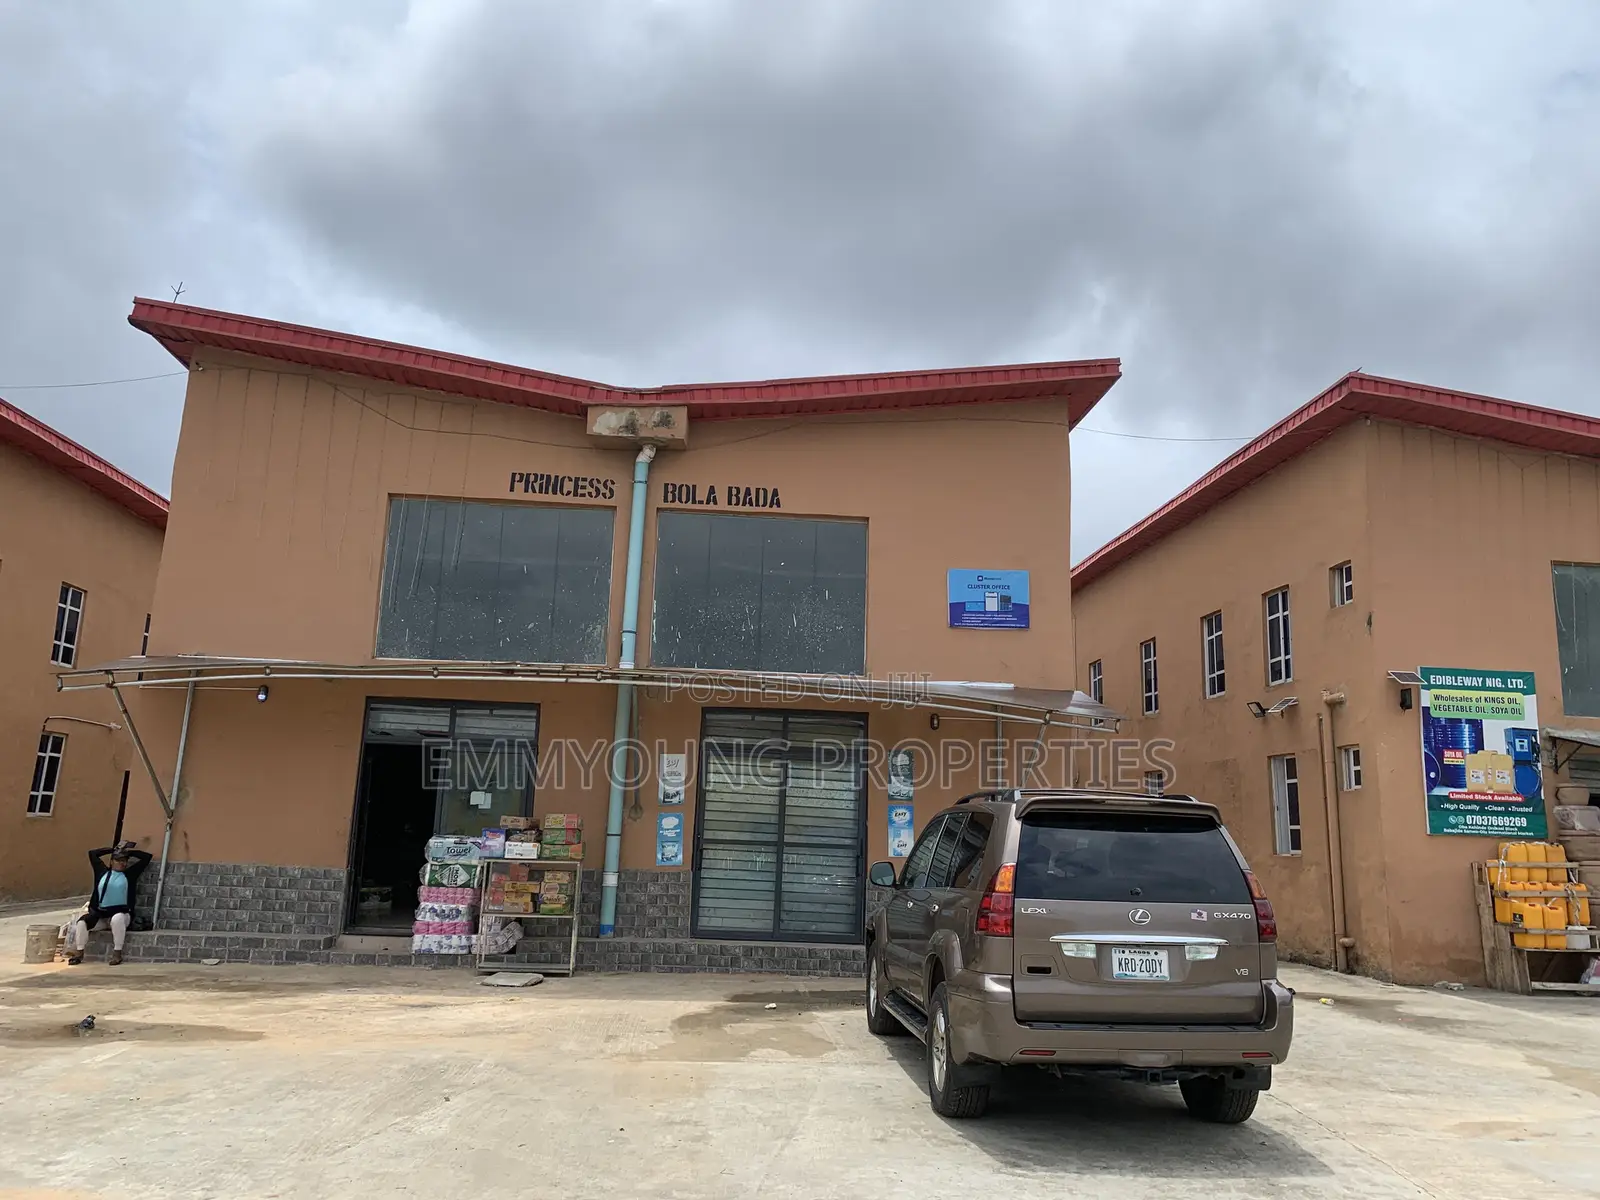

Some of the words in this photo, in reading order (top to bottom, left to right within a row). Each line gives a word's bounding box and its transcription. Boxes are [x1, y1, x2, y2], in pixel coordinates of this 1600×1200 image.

[509, 472, 616, 500] PRINCESS
[662, 482, 719, 506] BOLA
[726, 485, 782, 509] BADA
[1429, 674, 1483, 687] EDIBLEWAY
[1485, 677, 1505, 689] NIG.
[1507, 678, 1527, 689] LTD.
[1433, 693, 1474, 703] Wholesales
[1484, 696, 1505, 704] KINGS
[1433, 704, 1473, 713] VEGETABLE
[1491, 706, 1509, 715] SOYA
[1510, 707, 1522, 715] OIL
[1449, 792, 1473, 800] Limited
[1474, 793, 1492, 801] Stock
[1493, 794, 1522, 802] Available
[1444, 803, 1458, 811] High
[1459, 803, 1480, 811] Quality
[1465, 814, 1527, 827] 07037669269
[446, 846, 472, 854] Towel
[1213, 912, 1252, 920] GX470
[1234, 968, 1249, 976] V8
